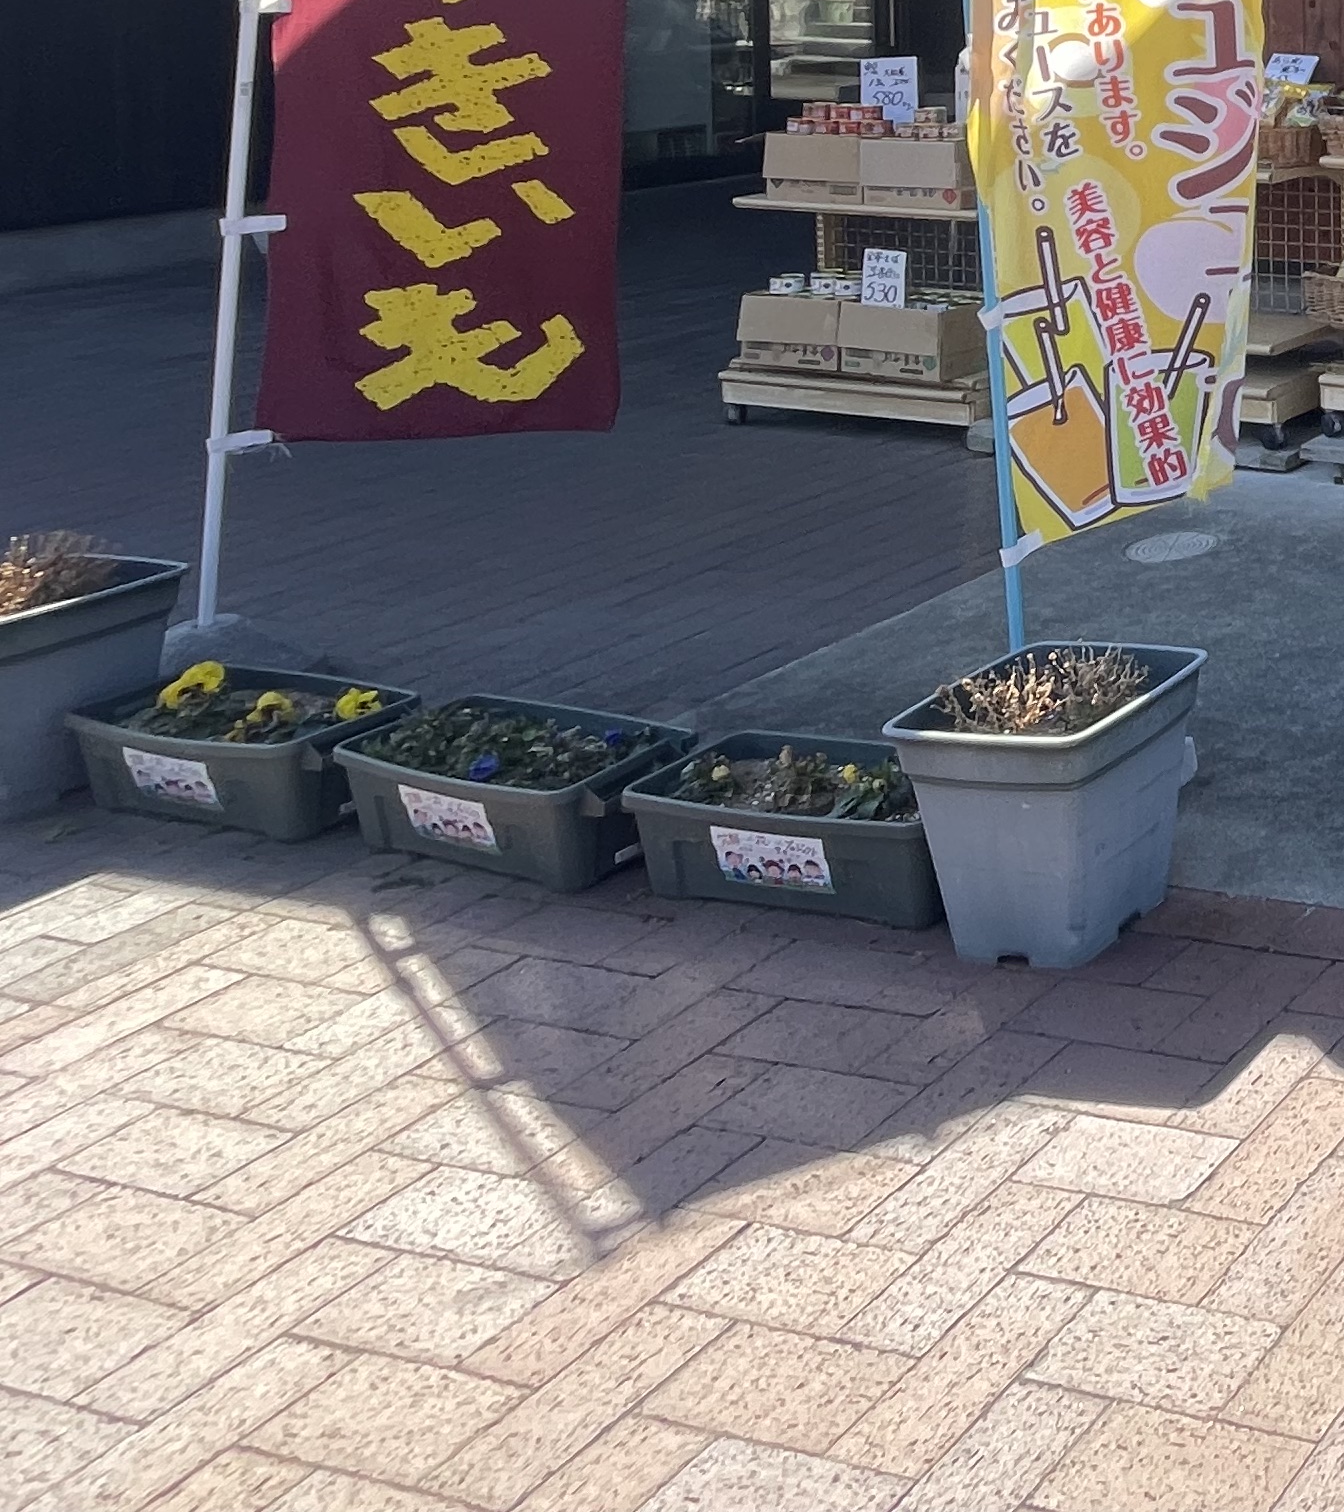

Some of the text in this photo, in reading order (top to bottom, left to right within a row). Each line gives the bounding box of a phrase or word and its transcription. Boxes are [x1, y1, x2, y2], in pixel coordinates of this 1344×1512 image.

[864, 281, 897, 303] 530
[1067, 182, 1188, 487] 美容と健康に効果的
